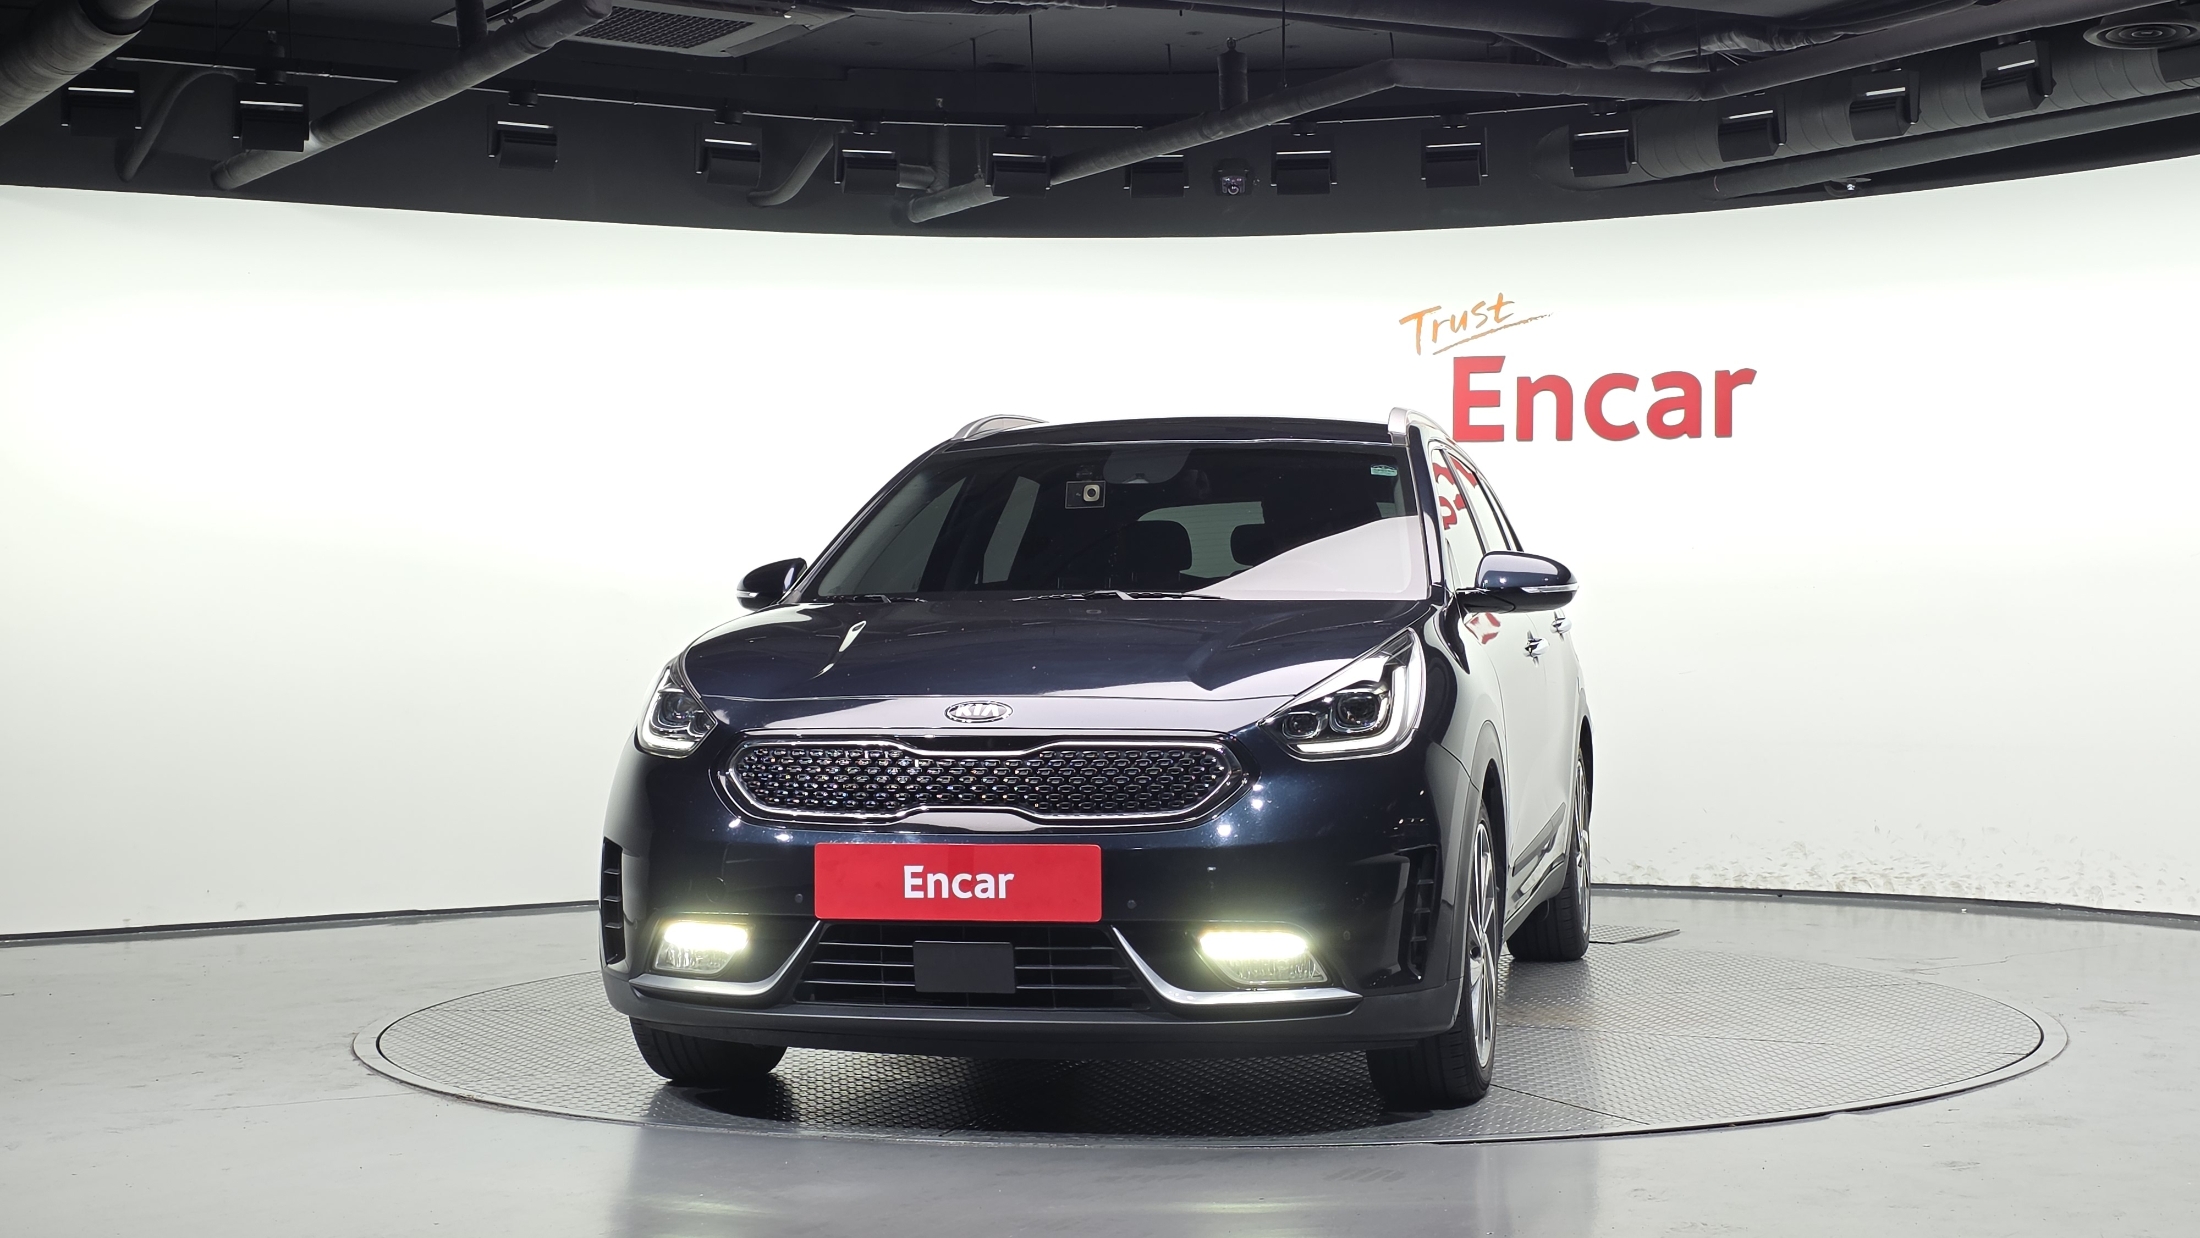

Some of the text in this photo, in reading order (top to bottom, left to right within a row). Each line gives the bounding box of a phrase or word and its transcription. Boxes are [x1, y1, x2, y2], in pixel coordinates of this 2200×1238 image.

[1399, 292, 1515, 355] Trust
[1453, 355, 1758, 442] Encar
[955, 703, 1000, 717] KIA
[903, 865, 1014, 899] Encar
